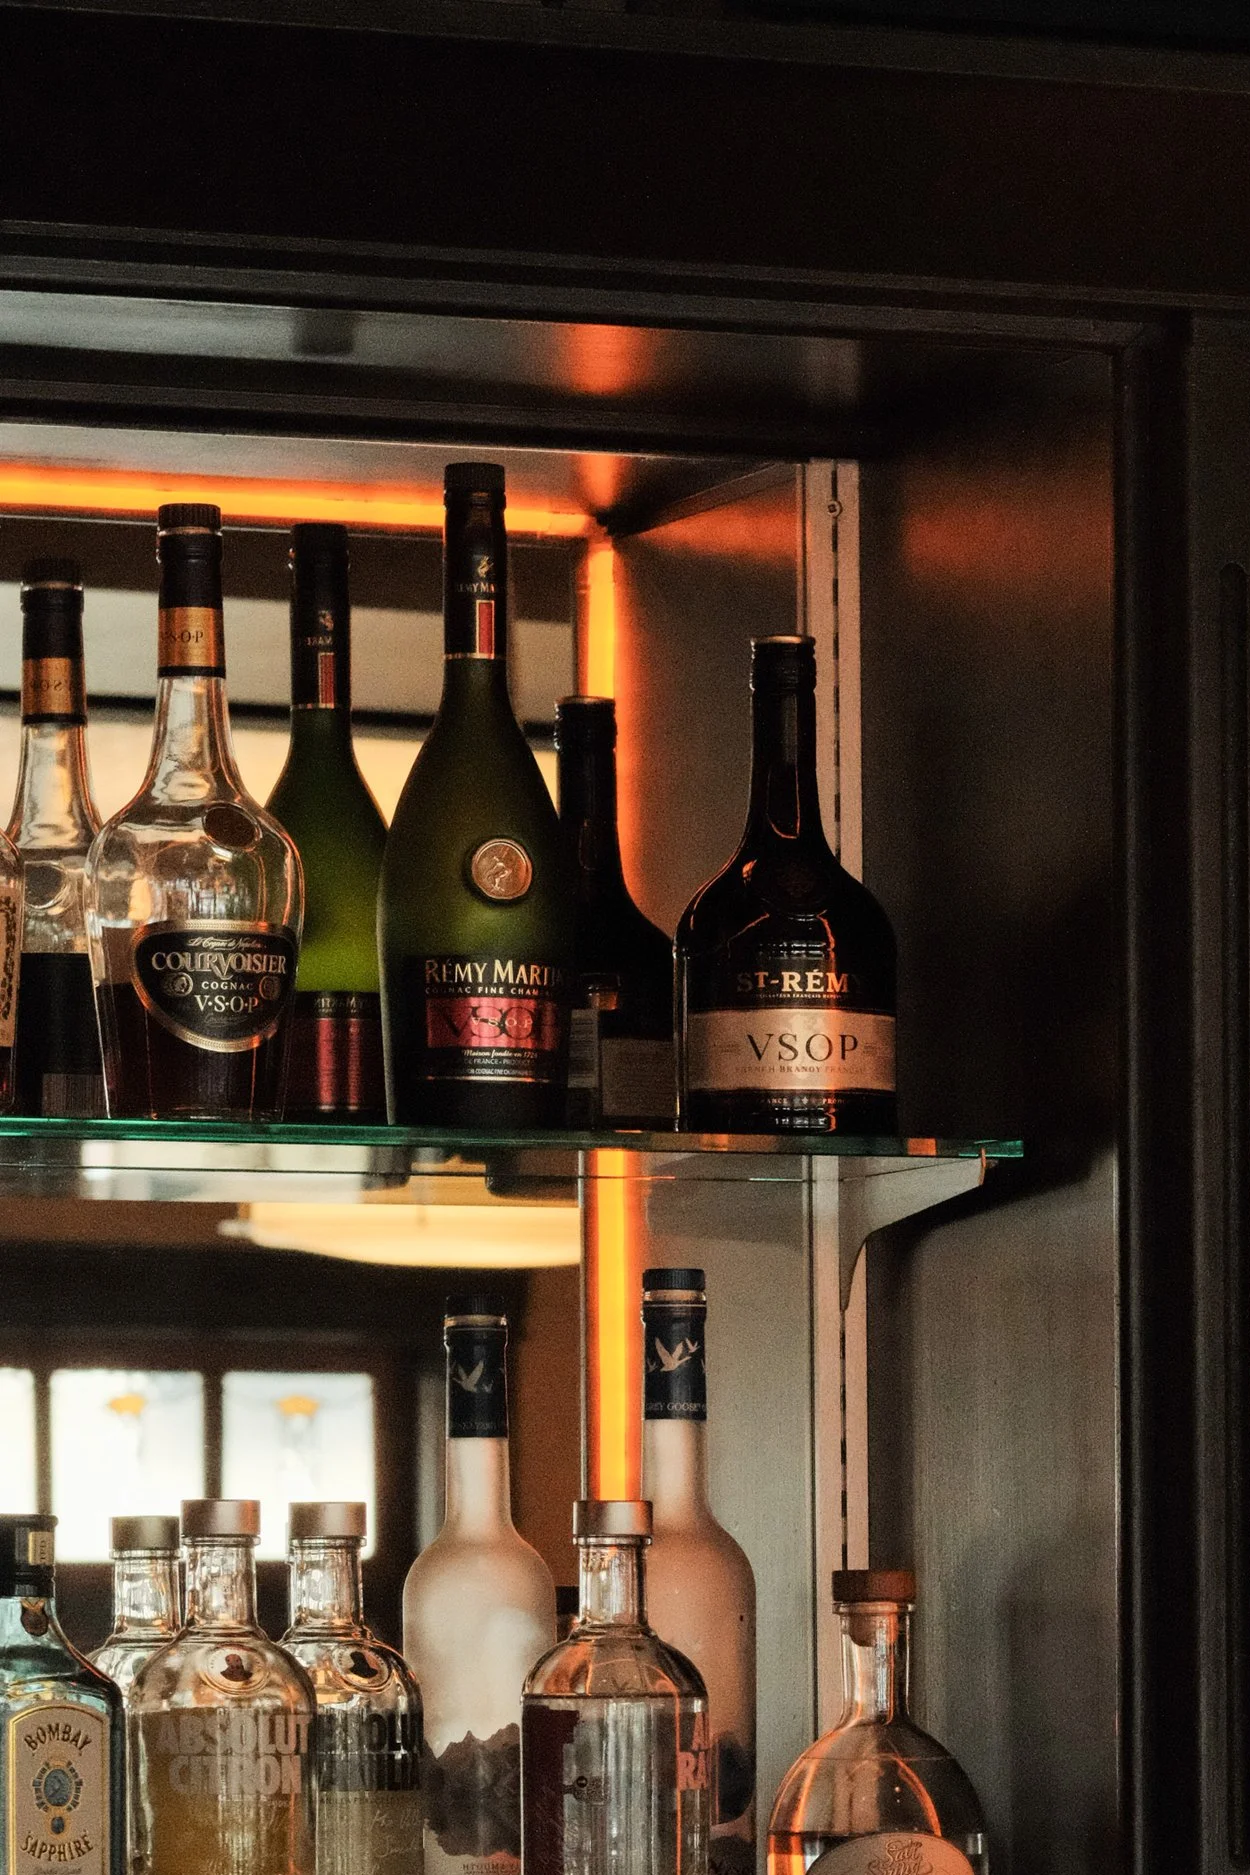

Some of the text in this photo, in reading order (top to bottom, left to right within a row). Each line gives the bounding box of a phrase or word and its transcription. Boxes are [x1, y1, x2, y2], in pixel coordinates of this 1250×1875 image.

[151, 951, 286, 981] COURVOISIER
[425, 959, 487, 984] RÉMY
[201, 980, 254, 991] COGNAC
[425, 986, 471, 995] COGNAC
[477, 986, 505, 995] FINE
[463, 1050, 489, 1058] Maison
[747, 1033, 859, 1062] VSOP
[779, 1064, 821, 1074] BRANDY
[667, 1401, 699, 1411] GOOSE
[24, 1722, 92, 1751] BOMBAY
[156, 1713, 313, 1754] ABSOLUT
[168, 1755, 302, 1795] CITRON
[20, 1833, 94, 1862] SAPPHIRE
